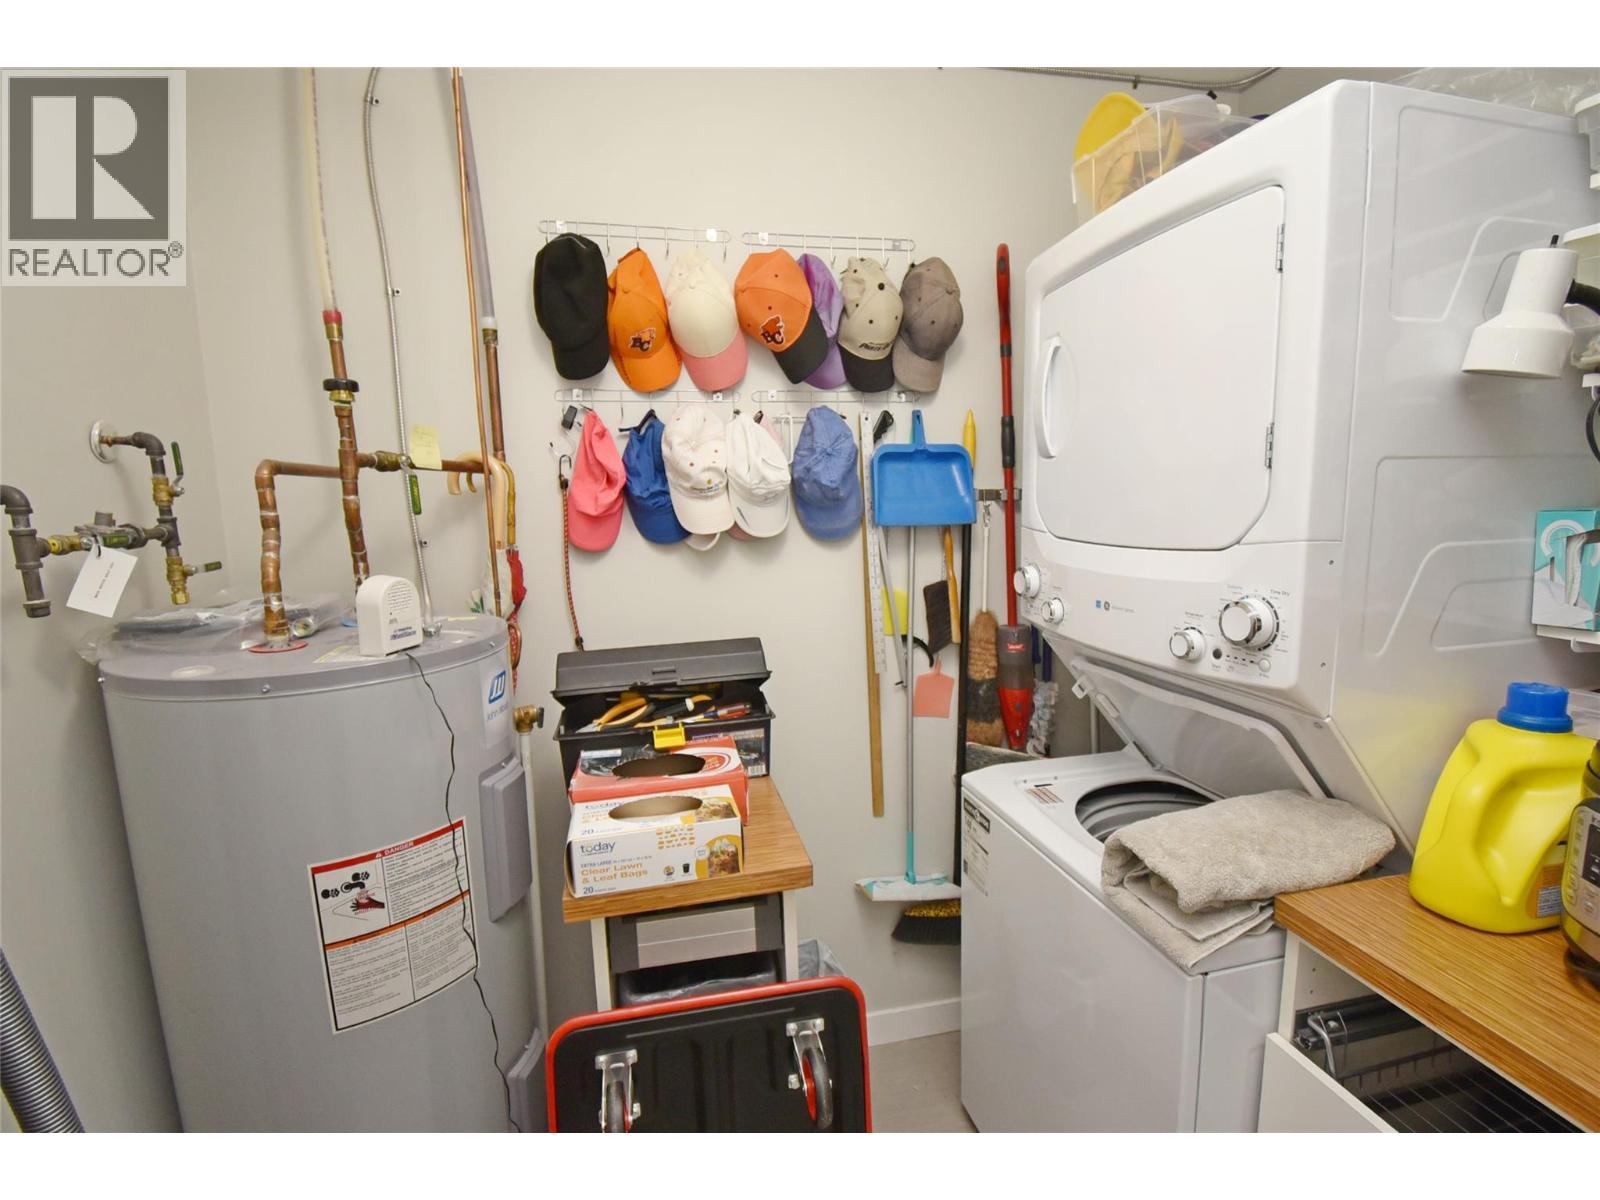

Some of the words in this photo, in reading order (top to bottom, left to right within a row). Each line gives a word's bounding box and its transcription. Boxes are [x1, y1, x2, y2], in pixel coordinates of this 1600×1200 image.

[384, 841, 415, 856] DANGER
[580, 841, 616, 853] today
[581, 867, 609, 876] Clear
[613, 862, 643, 871] Lawn
[593, 874, 617, 882] Leaf
[620, 869, 648, 879] Bags
[582, 886, 594, 895] 20
